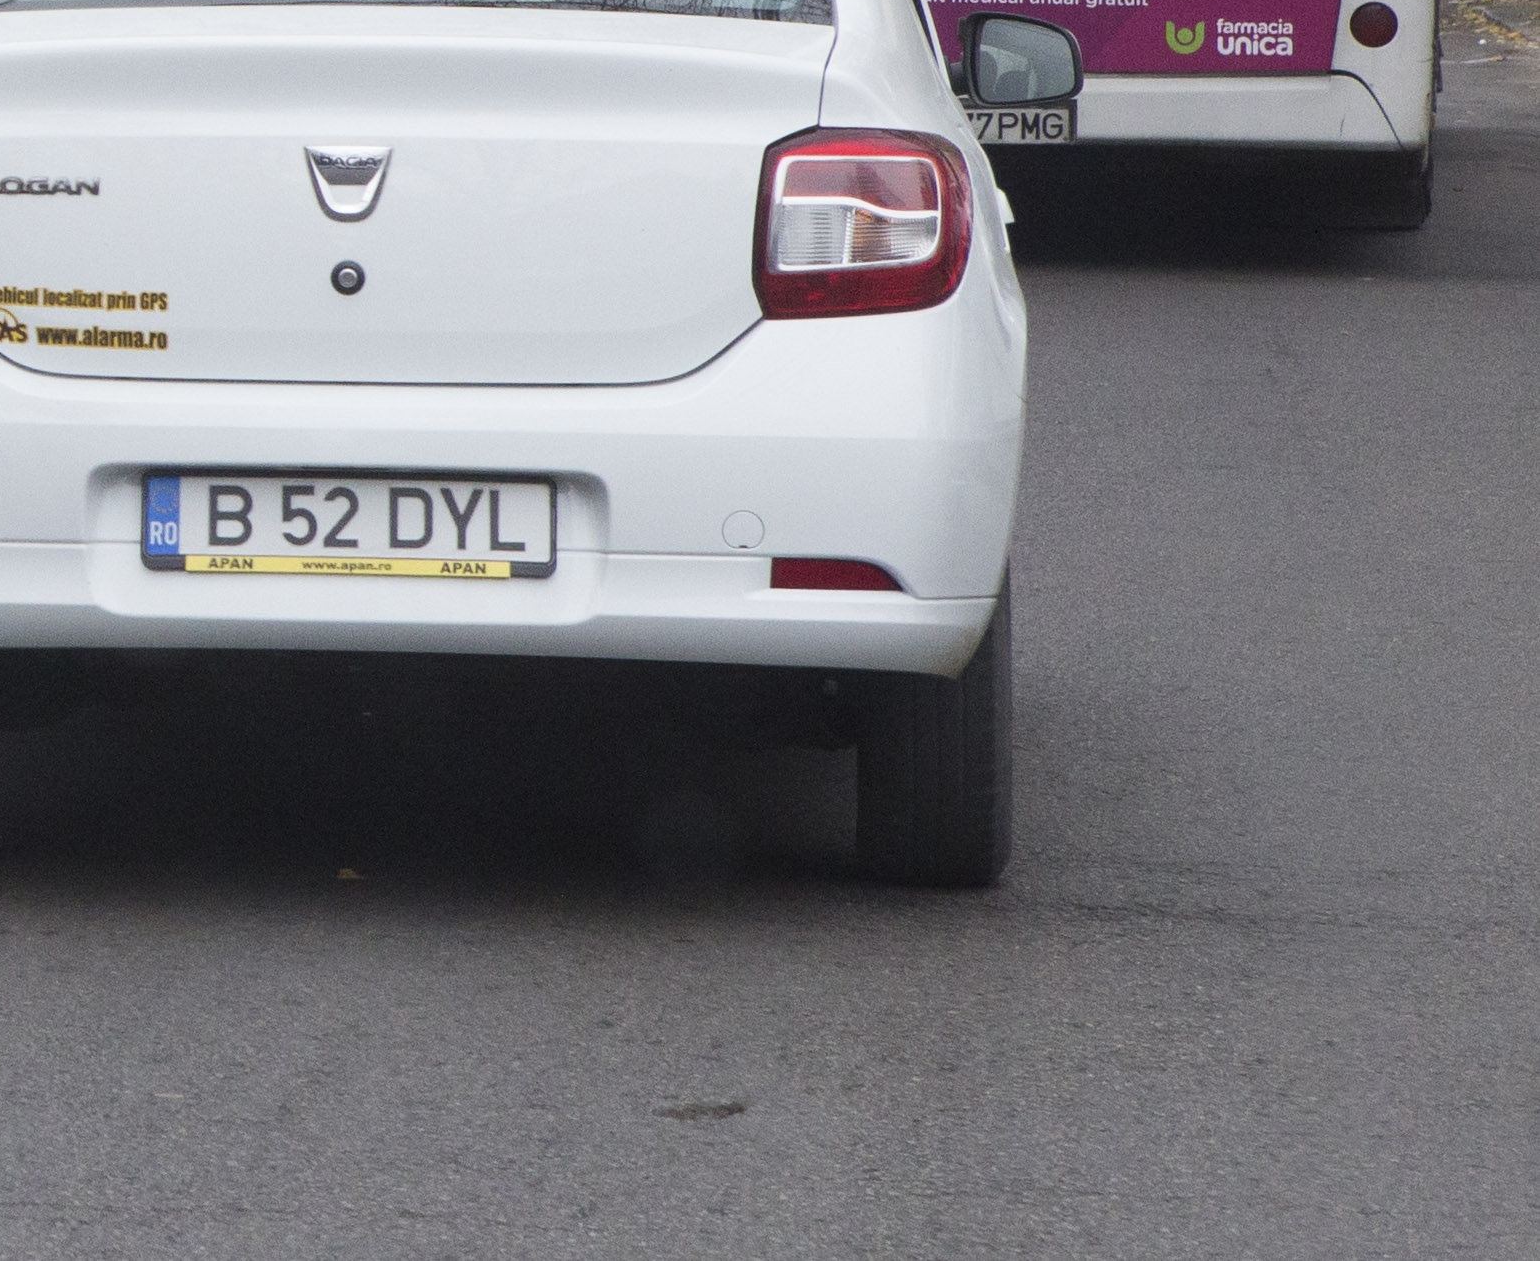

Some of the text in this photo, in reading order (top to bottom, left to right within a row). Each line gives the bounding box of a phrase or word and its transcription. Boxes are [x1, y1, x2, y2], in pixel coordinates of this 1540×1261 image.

[1216, 17, 1294, 35] farmacia
[1216, 34, 1294, 57] unica
[317, 156, 378, 169] DACIA
[42, 288, 104, 310] localizat
[107, 291, 136, 312] prin
[140, 291, 169, 311] GPS
[36, 325, 169, 350] www.alarma.ro
[149, 484, 526, 553] RO B 52 DYL
[207, 556, 487, 575] APAN www.apan.ro APAN
